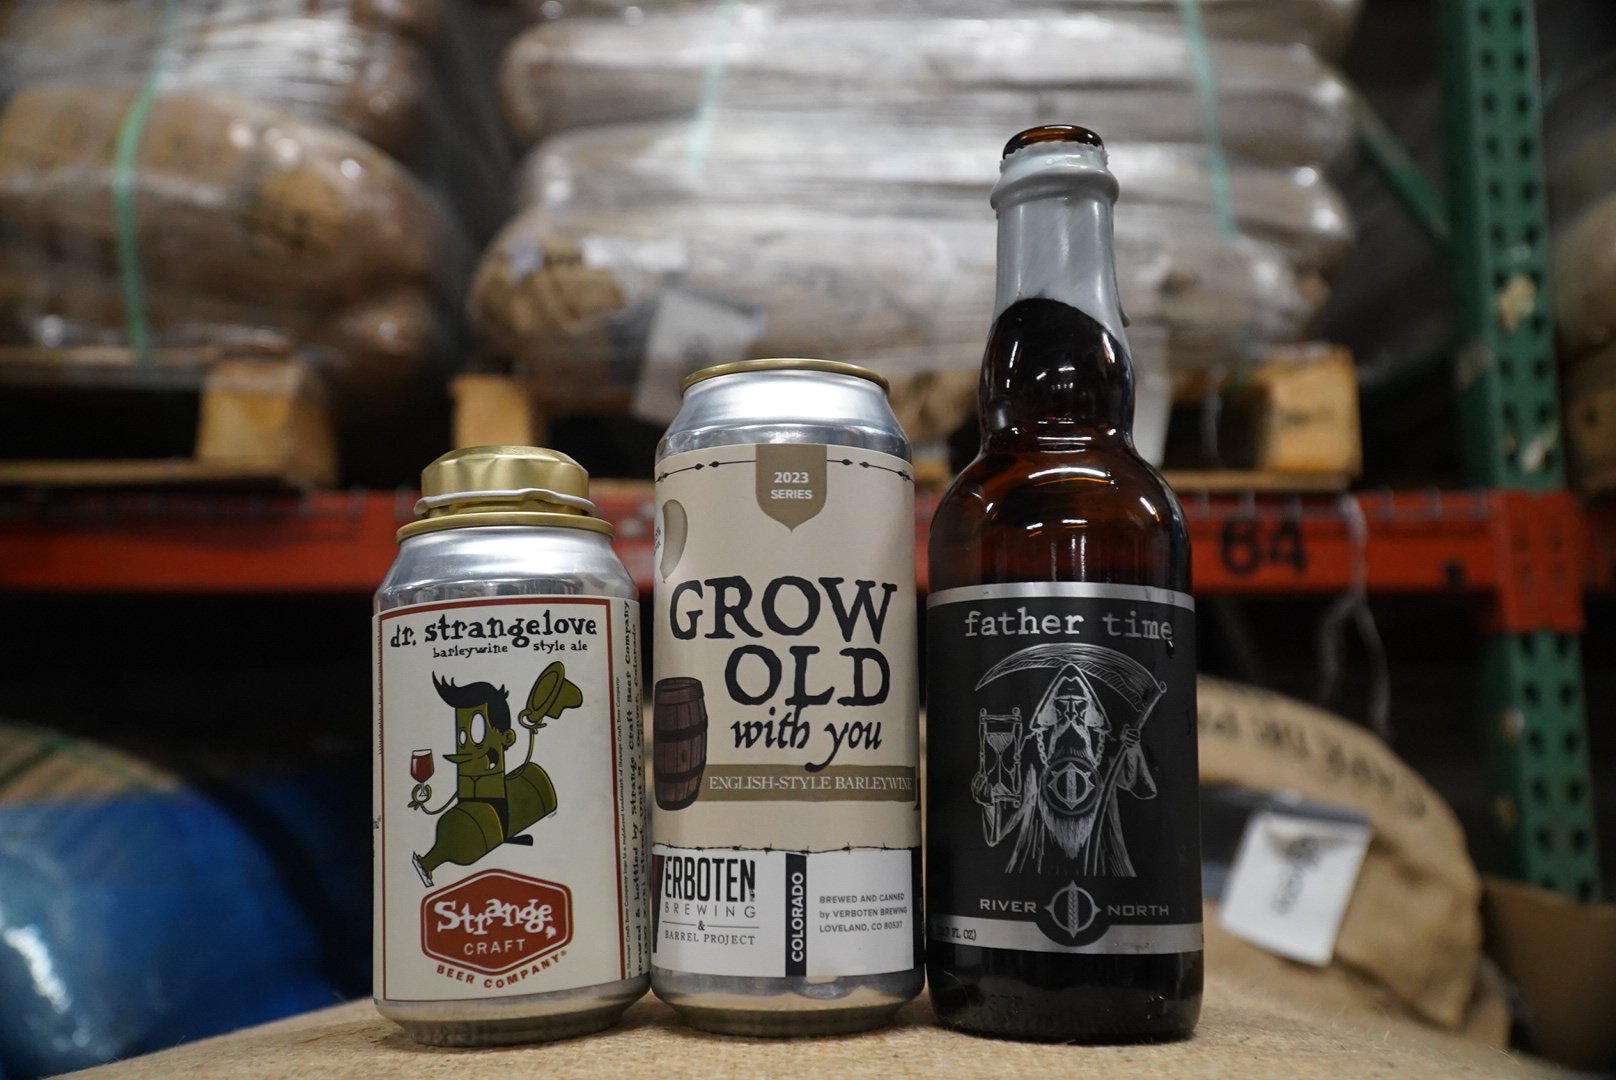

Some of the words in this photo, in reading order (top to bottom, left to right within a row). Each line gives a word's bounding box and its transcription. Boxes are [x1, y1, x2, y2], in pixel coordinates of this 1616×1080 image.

[774, 471, 809, 484] 2023
[770, 489, 813, 500] SERIES
[669, 575, 898, 644] GROW
[390, 624, 416, 648] dr.
[424, 610, 598, 648] strangelove
[964, 606, 1084, 638] father
[1102, 611, 1174, 640] time
[433, 643, 508, 659] barleywine
[533, 640, 566, 654] style
[570, 640, 588, 651] ale
[725, 644, 891, 706] OLD
[730, 704, 810, 749] with
[804, 721, 883, 772] you
[709, 775, 832, 791] ENGLISH-STYLE
[834, 776, 913, 791] BARLEYWINE
[819, 895, 858, 904] BREWED
[860, 894, 878, 902] AND
[879, 893, 905, 902] CANNED
[979, 898, 1037, 913] RIVER
[1107, 904, 1169, 917] NORTH
[664, 901, 756, 919] BREWING
[791, 872, 804, 962] COLORADO
[819, 910, 830, 920] by
[832, 908, 878, 918] VERBOTEN
[880, 906, 908, 916] BREWING
[697, 920, 705, 931] &
[819, 923, 870, 933] LOVELAND,
[871, 922, 882, 931] CO
[664, 929, 699, 943] BARREL
[703, 933, 756, 946] PROJECT
[463, 938, 526, 956] CRAFT
[436, 964, 475, 984] BEER
